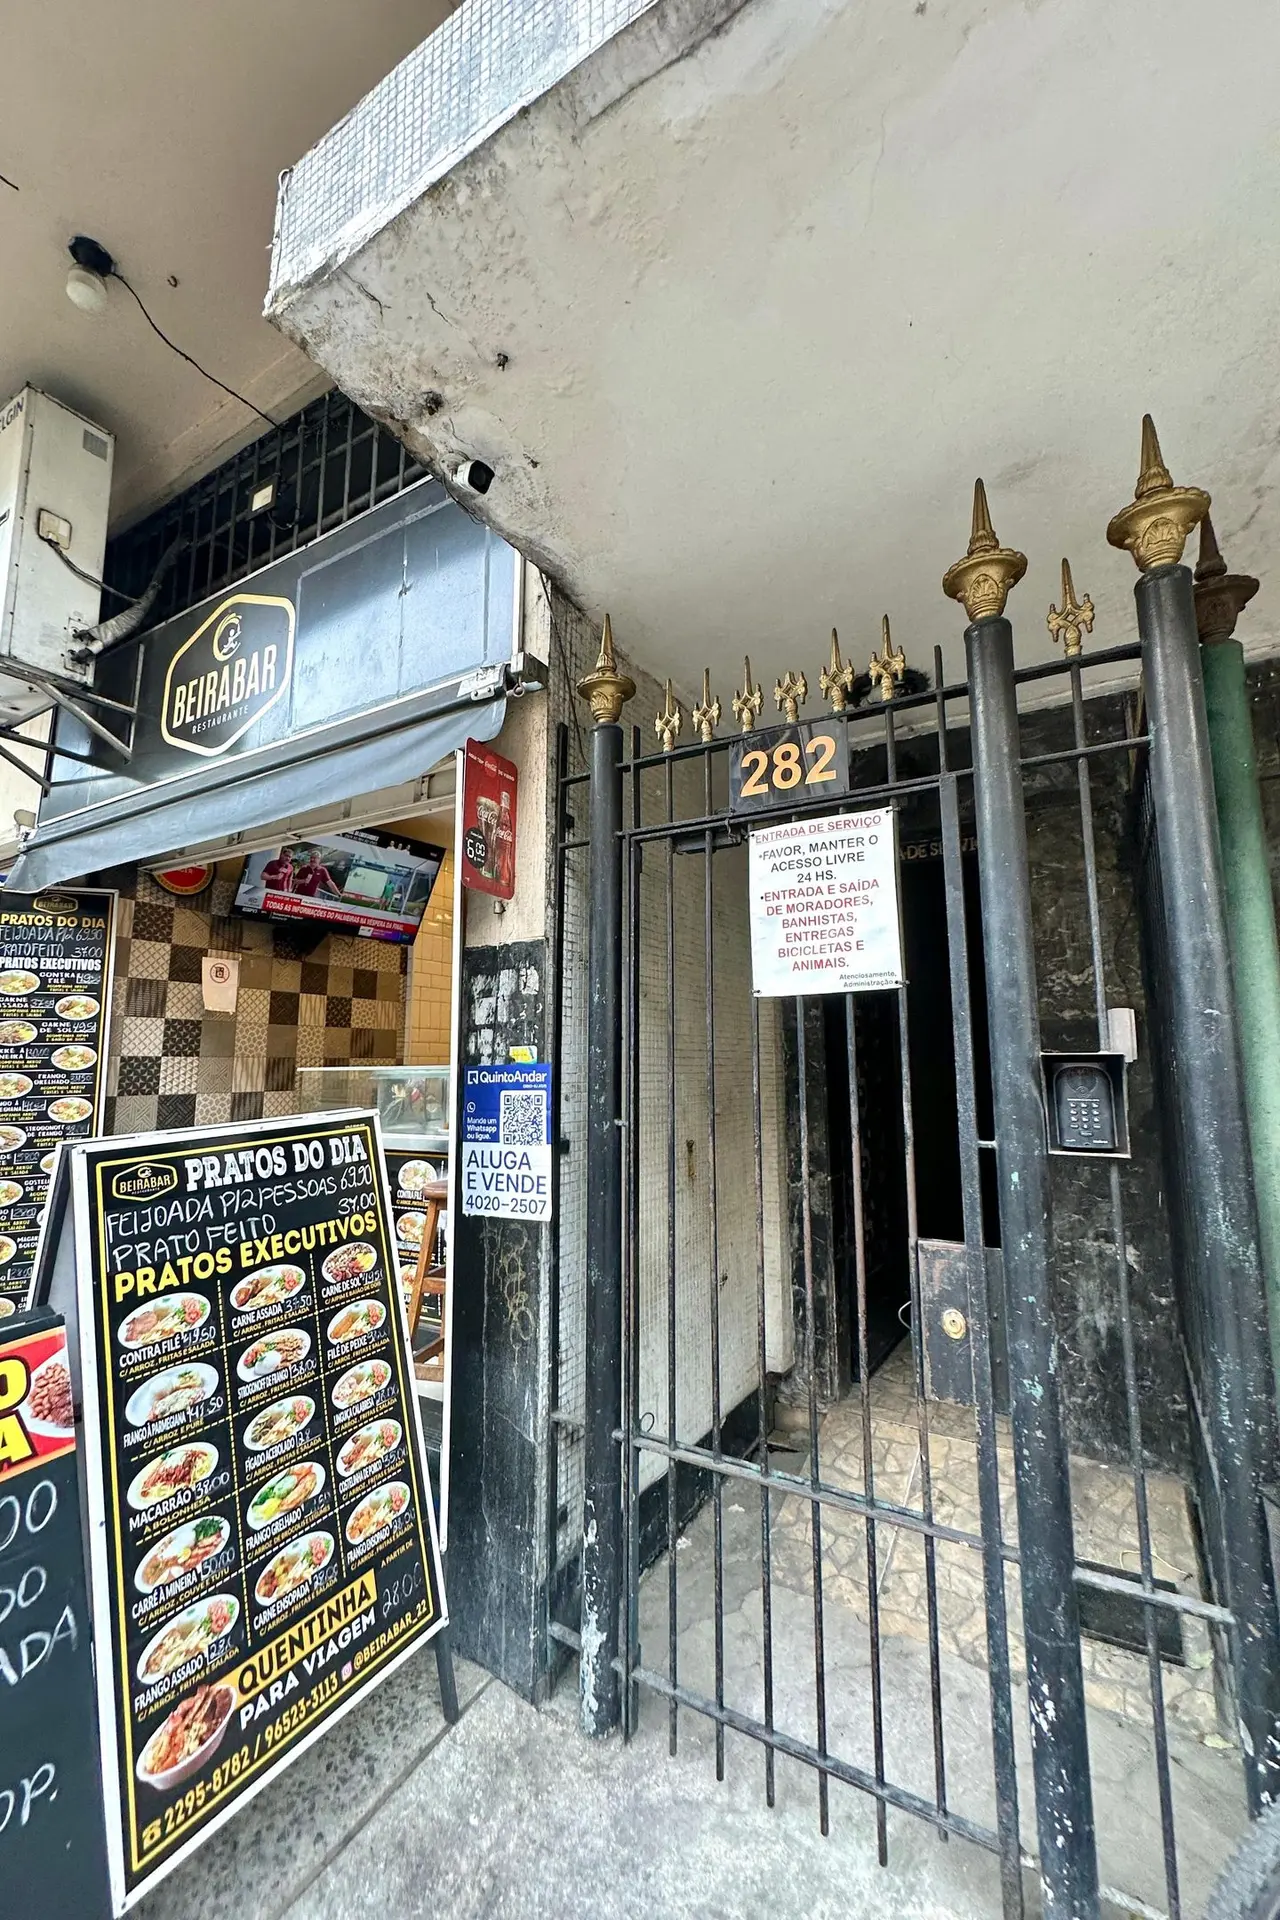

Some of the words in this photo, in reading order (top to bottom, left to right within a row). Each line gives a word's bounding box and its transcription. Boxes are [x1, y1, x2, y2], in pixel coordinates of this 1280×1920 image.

[0, 396, 24, 433] LGIN
[172, 644, 277, 729] BEIRABAR
[192, 704, 249, 735] RESTAURANTE
[740, 735, 837, 798] 282
[755, 826, 806, 844] ENTRADA
[808, 823, 824, 834] DE
[827, 814, 882, 830] SERVIÇO
[763, 844, 806, 861] FAVOR,
[808, 836, 865, 853] MANTER
[868, 834, 879, 845] O
[770, 856, 823, 873] ACESSO
[825, 851, 865, 866] LIVRE
[764, 885, 824, 902] ENTRADA
[827, 884, 836, 895] E
[839, 878, 880, 894] SAÍDA
[797, 873, 812, 884] 24
[815, 870, 837, 881] HS.
[266, 900, 284, 911] TODAS
[285, 904, 292, 912] AS
[292, 904, 327, 918] INFORMAÇÕES
[327, 911, 334, 919] DO
[766, 904, 783, 916] DE
[786, 894, 874, 914] MORADORES,
[1, 913, 53, 926] PRATOS
[57, 916, 78, 927] DO
[81, 917, 105, 928] DIA
[782, 911, 858, 929] BANHISTAS,
[785, 926, 855, 943] ENTREGAS
[778, 941, 852, 958] BICICLETAS
[856, 940, 865, 951] E
[0, 956, 39, 970] PRATOS
[40, 958, 101, 971] EXECUTIVOS
[792, 957, 849, 972] ANIMAIS.
[843, 979, 894, 988] Administração
[479, 1070, 548, 1084] QuintoAndar
[466, 1124, 497, 1133] Whatsapp
[184, 1146, 287, 1192] PRATOS
[292, 1140, 325, 1172] DO
[329, 1134, 368, 1166] DIA
[466, 1150, 532, 1171] ALUGA
[119, 1174, 172, 1194] BEIRABAR
[467, 1171, 477, 1190] E
[481, 1172, 547, 1195] VENDE
[107, 1195, 214, 1243] FEIJOADA
[259, 1176, 338, 1210] PESSOAS
[466, 1195, 547, 1215] 4020-2507
[112, 1229, 200, 1271] PRATO
[206, 1214, 276, 1250] FEITO
[115, 1246, 233, 1303] PRATOS
[240, 1210, 377, 1268] EXECUTIVOS
[321, 1282, 343, 1299] CARNE
[350, 1276, 362, 1288] SOL
[231, 1310, 257, 1329] CARNE
[256, 1302, 283, 1319] ASSADA
[119, 1369, 128, 1378] C/
[158, 1351, 183, 1364] FRITAS
[187, 1340, 215, 1353] SALADA
[120, 1343, 161, 1369] CONTRA
[162, 1334, 180, 1353] FILÉ
[327, 1345, 341, 1362] FILÉ
[350, 1335, 368, 1350] PEIXE
[123, 1428, 147, 1448] FRANGO
[143, 1439, 152, 1449] C/
[153, 1430, 179, 1443] ARROZ
[129, 1488, 192, 1532] MACARRÃO
[152, 1495, 211, 1530] BOLONHESA
[245, 1527, 272, 1552] FRANGO
[271, 1507, 303, 1536] GRELHADO
[386, 1545, 405, 1564] PARTIR
[132, 1592, 160, 1619] CARRÉ
[165, 1569, 198, 1596] MINEIRA
[253, 1606, 278, 1631] CARNE
[277, 1586, 310, 1615] ENSOPADA
[238, 1579, 372, 1697] QUENTINHA
[239, 1669, 300, 1731] PARA
[301, 1606, 376, 1677] VIAGEM
[134, 1676, 171, 1714] FRANGO
[170, 1654, 204, 1688] ASSADO
[164, 1745, 250, 1835] 2295-8782
[264, 1670, 339, 1748] 96523-3113
[353, 1599, 427, 1670] @BEIRABAR_22
